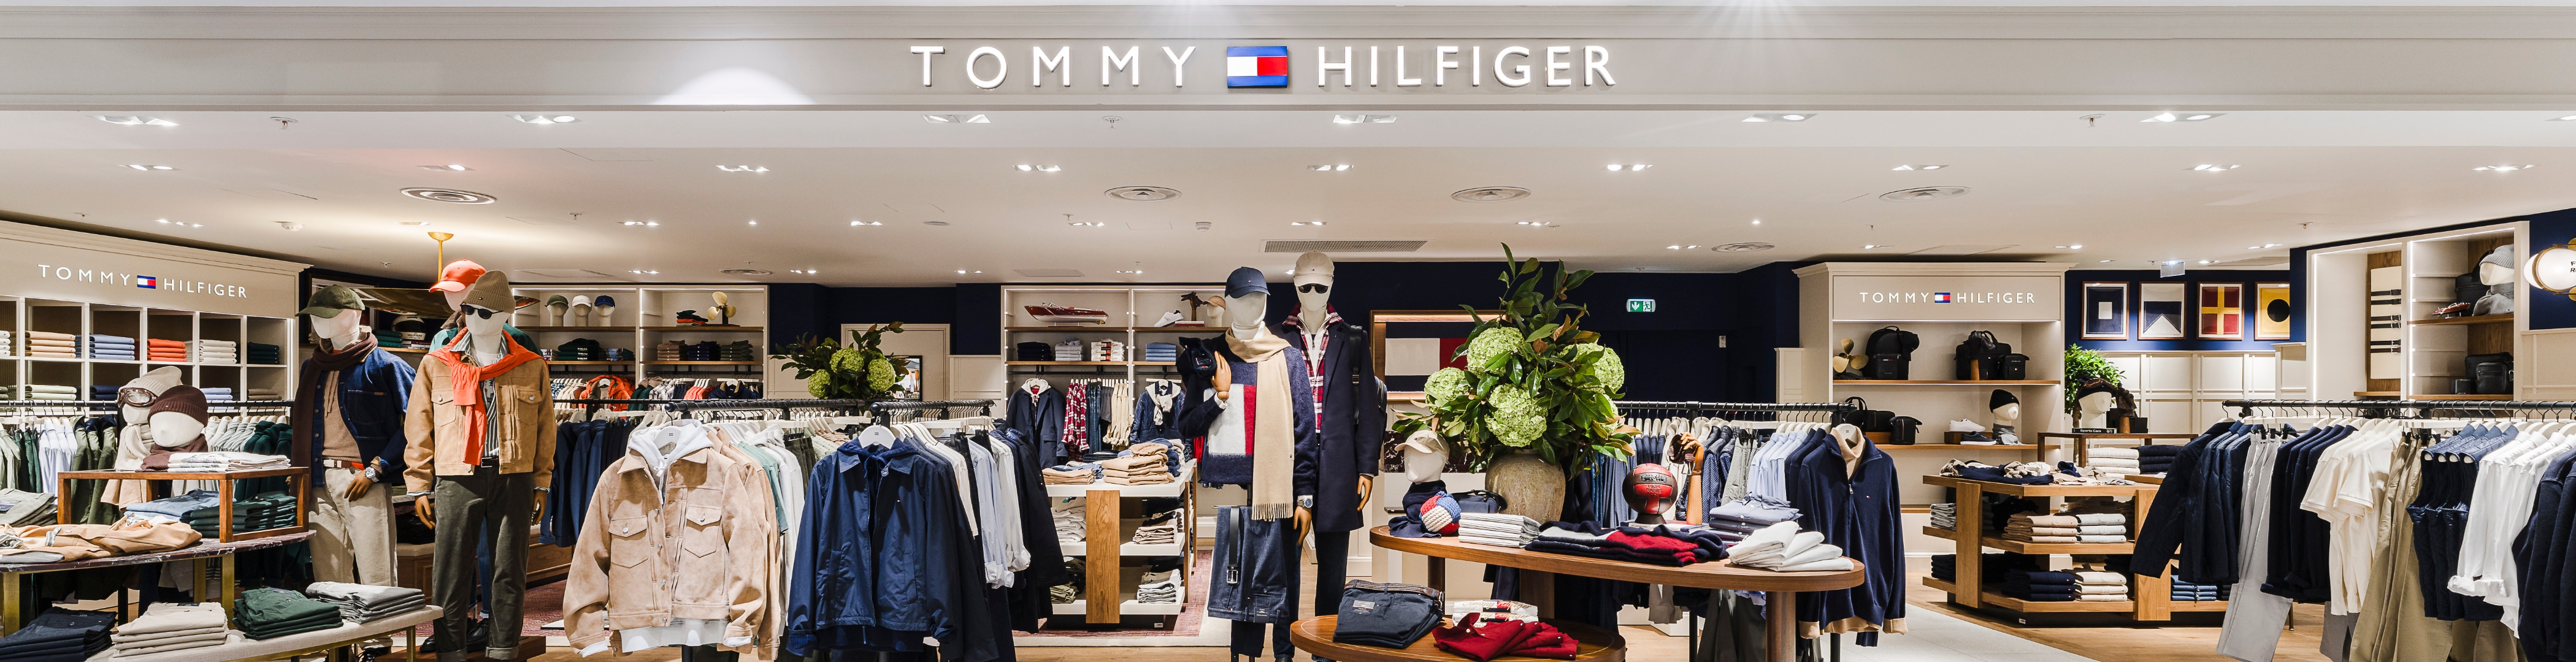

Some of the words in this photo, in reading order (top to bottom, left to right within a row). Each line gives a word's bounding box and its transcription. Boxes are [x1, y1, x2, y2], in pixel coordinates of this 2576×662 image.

[910, 45, 1197, 88] TOMMY
[1317, 45, 1616, 87] HILFIGER
[37, 264, 131, 286] TOMMY
[163, 278, 247, 299] HILFIGER
[1859, 292, 1930, 303] TOMMY
[1957, 292, 2035, 303] HILFIGER
[1462, 601, 1495, 610] Tommy
